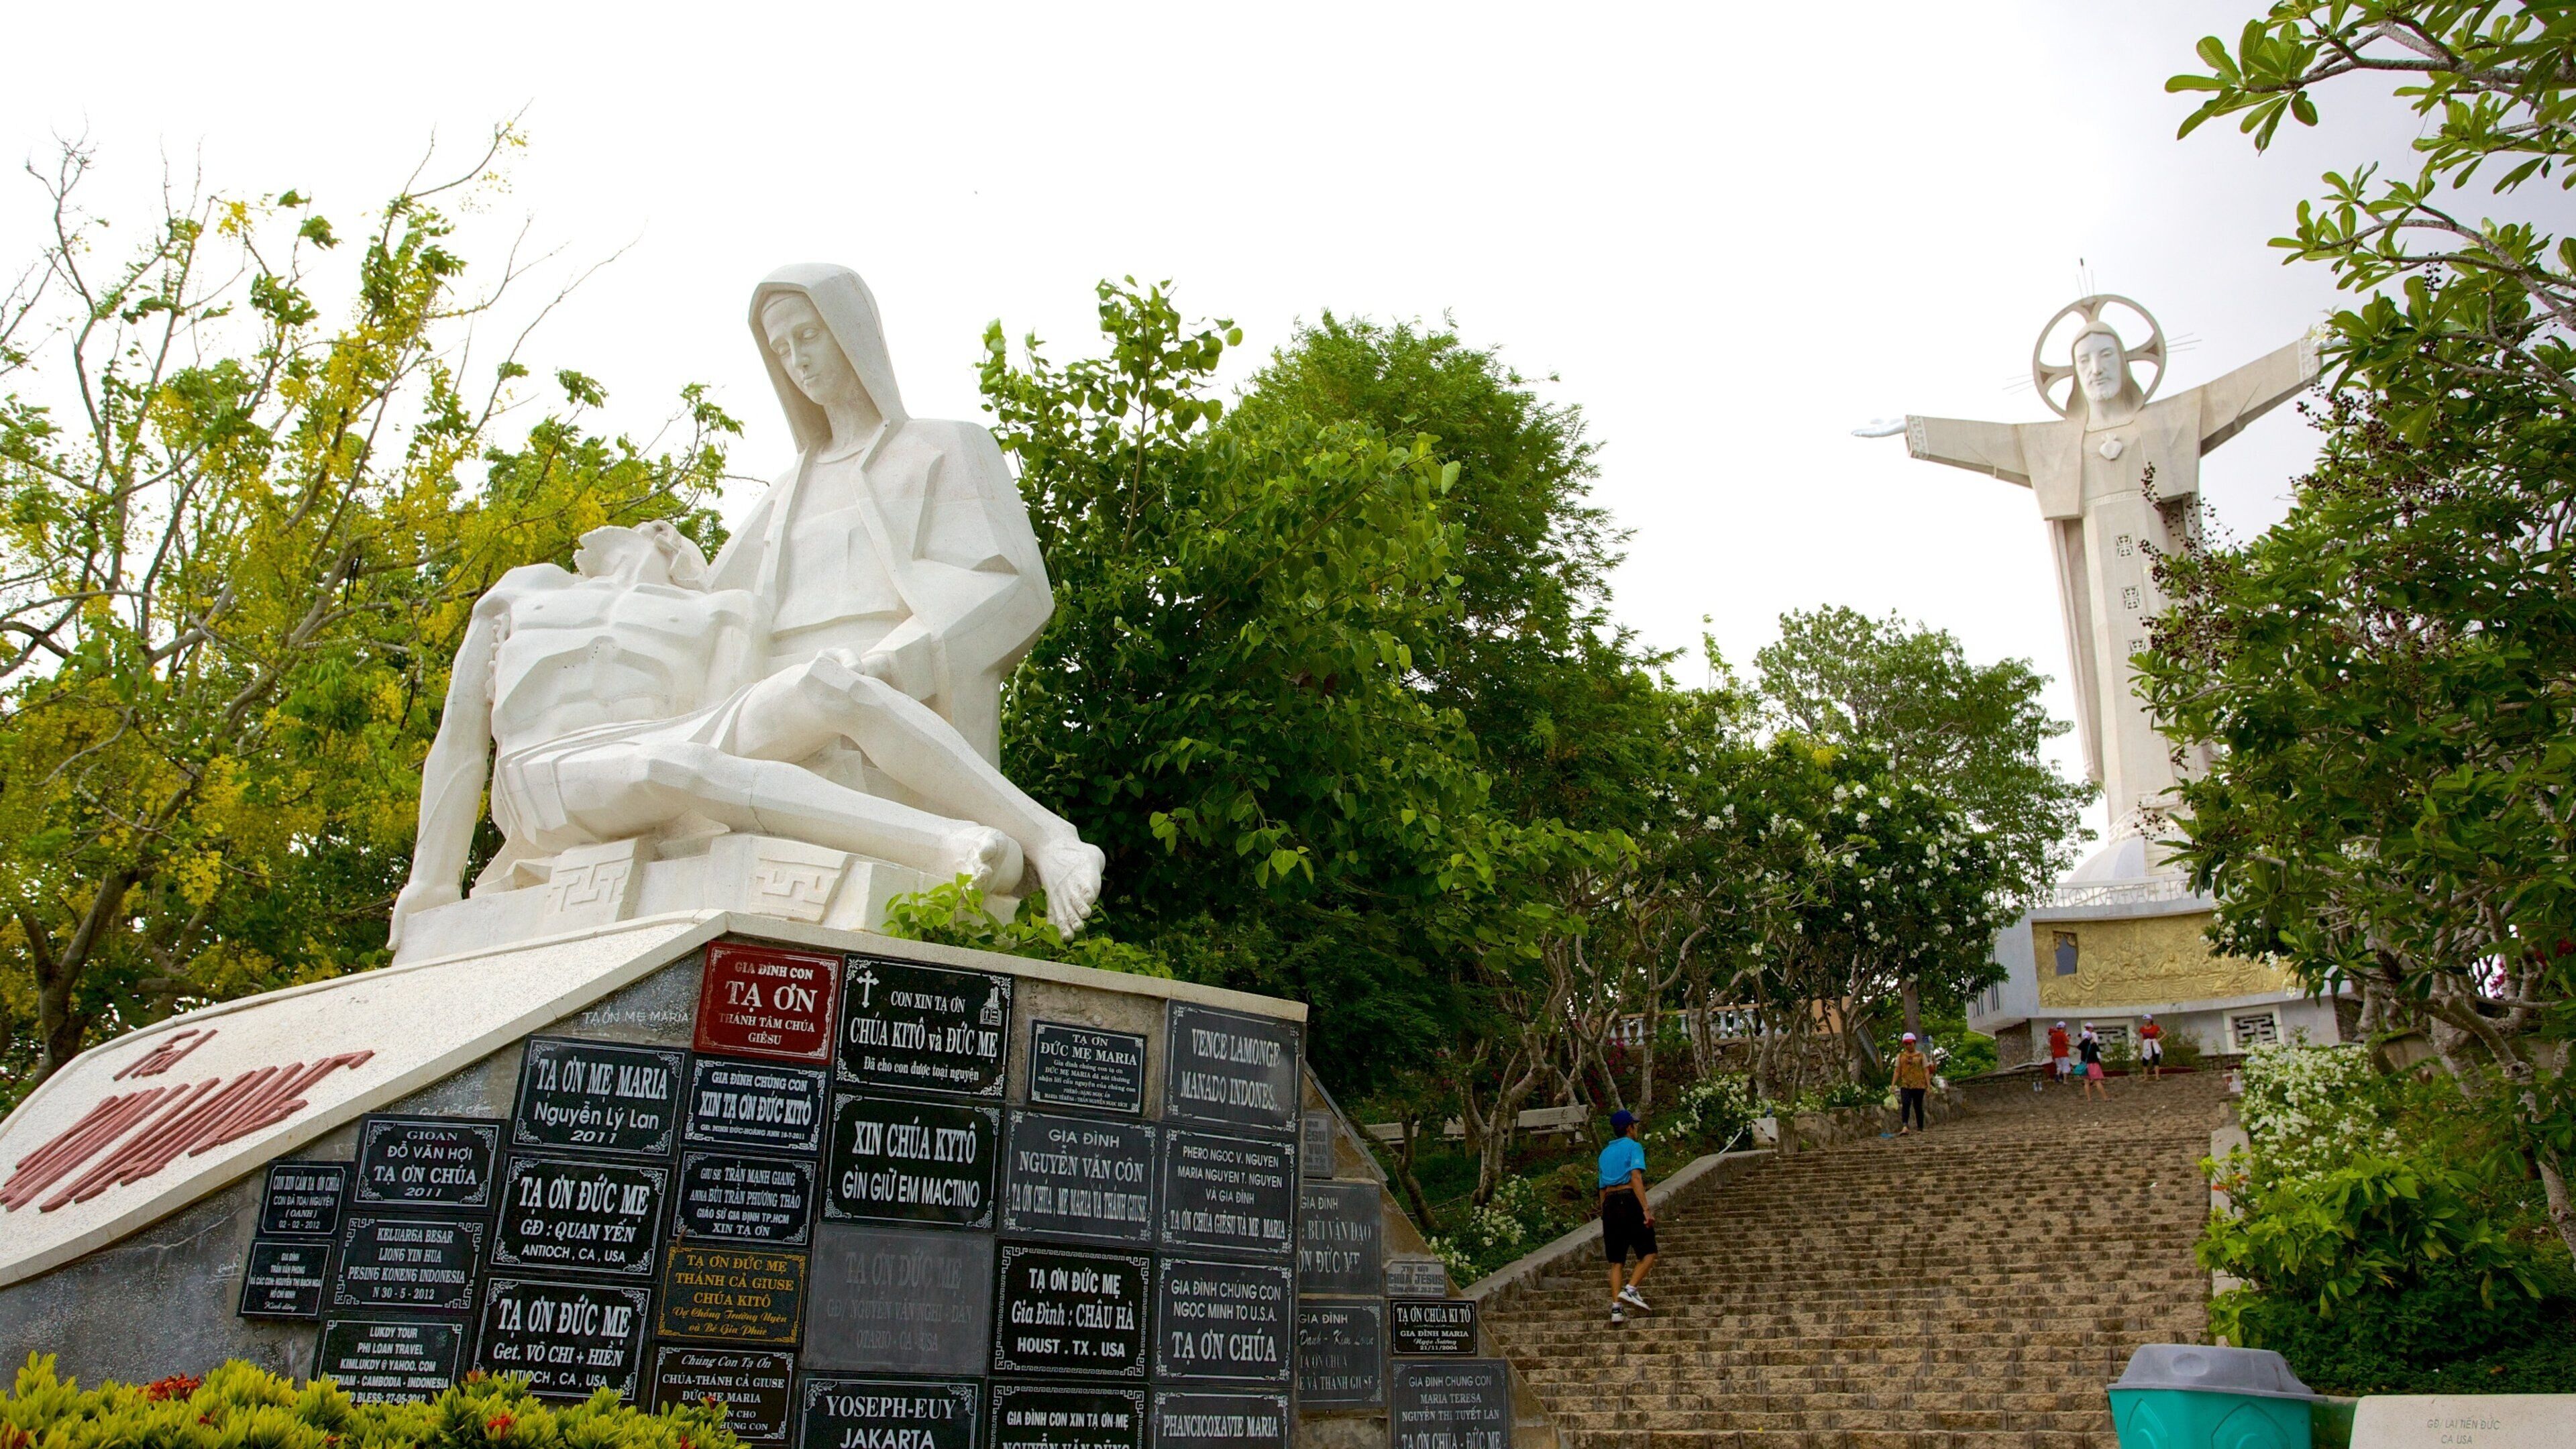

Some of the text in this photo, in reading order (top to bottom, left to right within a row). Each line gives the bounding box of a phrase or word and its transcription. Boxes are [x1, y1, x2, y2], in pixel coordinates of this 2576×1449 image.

[735, 962, 814, 979] GIA ĐÌNH CON
[725, 981, 817, 1013] TẠ ƠN
[891, 991, 965, 1014] CON XIN TẠ ƠN
[719, 1012, 814, 1032] THÁNH TÂM CHÚA
[748, 1032, 782, 1045] GIÊSU
[850, 1012, 998, 1063] CHÚA KITÔ và ĐỨC MẸ
[1073, 1034, 1109, 1046] TẠ ƠN
[1191, 1028, 1280, 1068] VENCE LAMONGE
[1040, 1040, 1137, 1065] ĐỨC MẸ MARIA
[537, 1056, 667, 1103] TẠ ƠN MẸ MARIA
[877, 1058, 892, 1071] cho
[894, 1062, 908, 1073] con
[932, 1063, 948, 1080] toại
[712, 1071, 808, 1091] GIA ĐÌNH CHÚNG CON
[1181, 1071, 1282, 1111] MANADO INDONES
[535, 1101, 659, 1130] Nguyễn Lý Lan
[699, 1090, 812, 1126] XIN TẠ ƠN ĐỨC KITÔ
[407, 1131, 458, 1140] GIOAN
[570, 1130, 616, 1143] 2011
[853, 1116, 976, 1164] XIN CHÚA KYTÔ
[1049, 1129, 1120, 1148] GIA ĐÌNH
[387, 1141, 472, 1162] ĐỖ VĂN HỢI
[1183, 1146, 1279, 1168] PHERO NGOC V. NGUYEN
[1019, 1145, 1144, 1183] NGUYỄN VĂN CÔN
[374, 1165, 477, 1185] TẠ ƠN CHÚA
[1178, 1165, 1282, 1188] MARIA NGUYEN T. NGUYEN
[405, 1187, 442, 1197] 2011
[843, 1165, 980, 1208] GÌN GIỮ EM MACTINO
[1205, 1186, 1254, 1204] VÀ GIA ĐÌNH
[519, 1174, 650, 1222] TẠ ƠN ĐỨC MẸ
[555, 1222, 600, 1240] QUAN
[604, 1218, 637, 1242] YẾN
[522, 1244, 625, 1263] ANTIOCH CA USA
[687, 1254, 788, 1274] TẠ ƠN ĐỨC MẸ
[676, 1271, 794, 1291] THÁNH CẢ GIUSE
[1029, 1267, 1121, 1299] TẠ ƠN ĐỨC MẸ
[1171, 1277, 1281, 1301] GIA ĐÌNH CHÚNG CON
[694, 1289, 771, 1307] CHÚA KITÔ
[498, 1294, 632, 1346] TẠ ƠN ĐỨC MẸ
[1012, 1299, 1134, 1330] Gia Đình CHÂU HÀ
[1174, 1301, 1277, 1322] NGỌC MINH TO U.S.A.
[370, 1326, 418, 1338] LUKDY TOUR
[358, 1343, 423, 1355] PHI LOAN TRAVEL
[1017, 1337, 1125, 1357] HOUST TX USA
[1172, 1328, 1277, 1365] TẠ ƠN CHÚA
[682, 1355, 716, 1368] Chúng
[718, 1356, 738, 1367] Con
[741, 1357, 753, 1370] Tạ
[735, 1373, 749, 1387] CẢ
[753, 1377, 785, 1388] GIUSE
[826, 1395, 957, 1419] YOSEPH-EUY
[1420, 1393, 1481, 1403] MARIA TERESA
[1163, 1415, 1278, 1438] PHANCICOXAVIE MARIA
[839, 1428, 935, 1449] JAKARTA
[2441, 1435, 2473, 1444] CA USA
